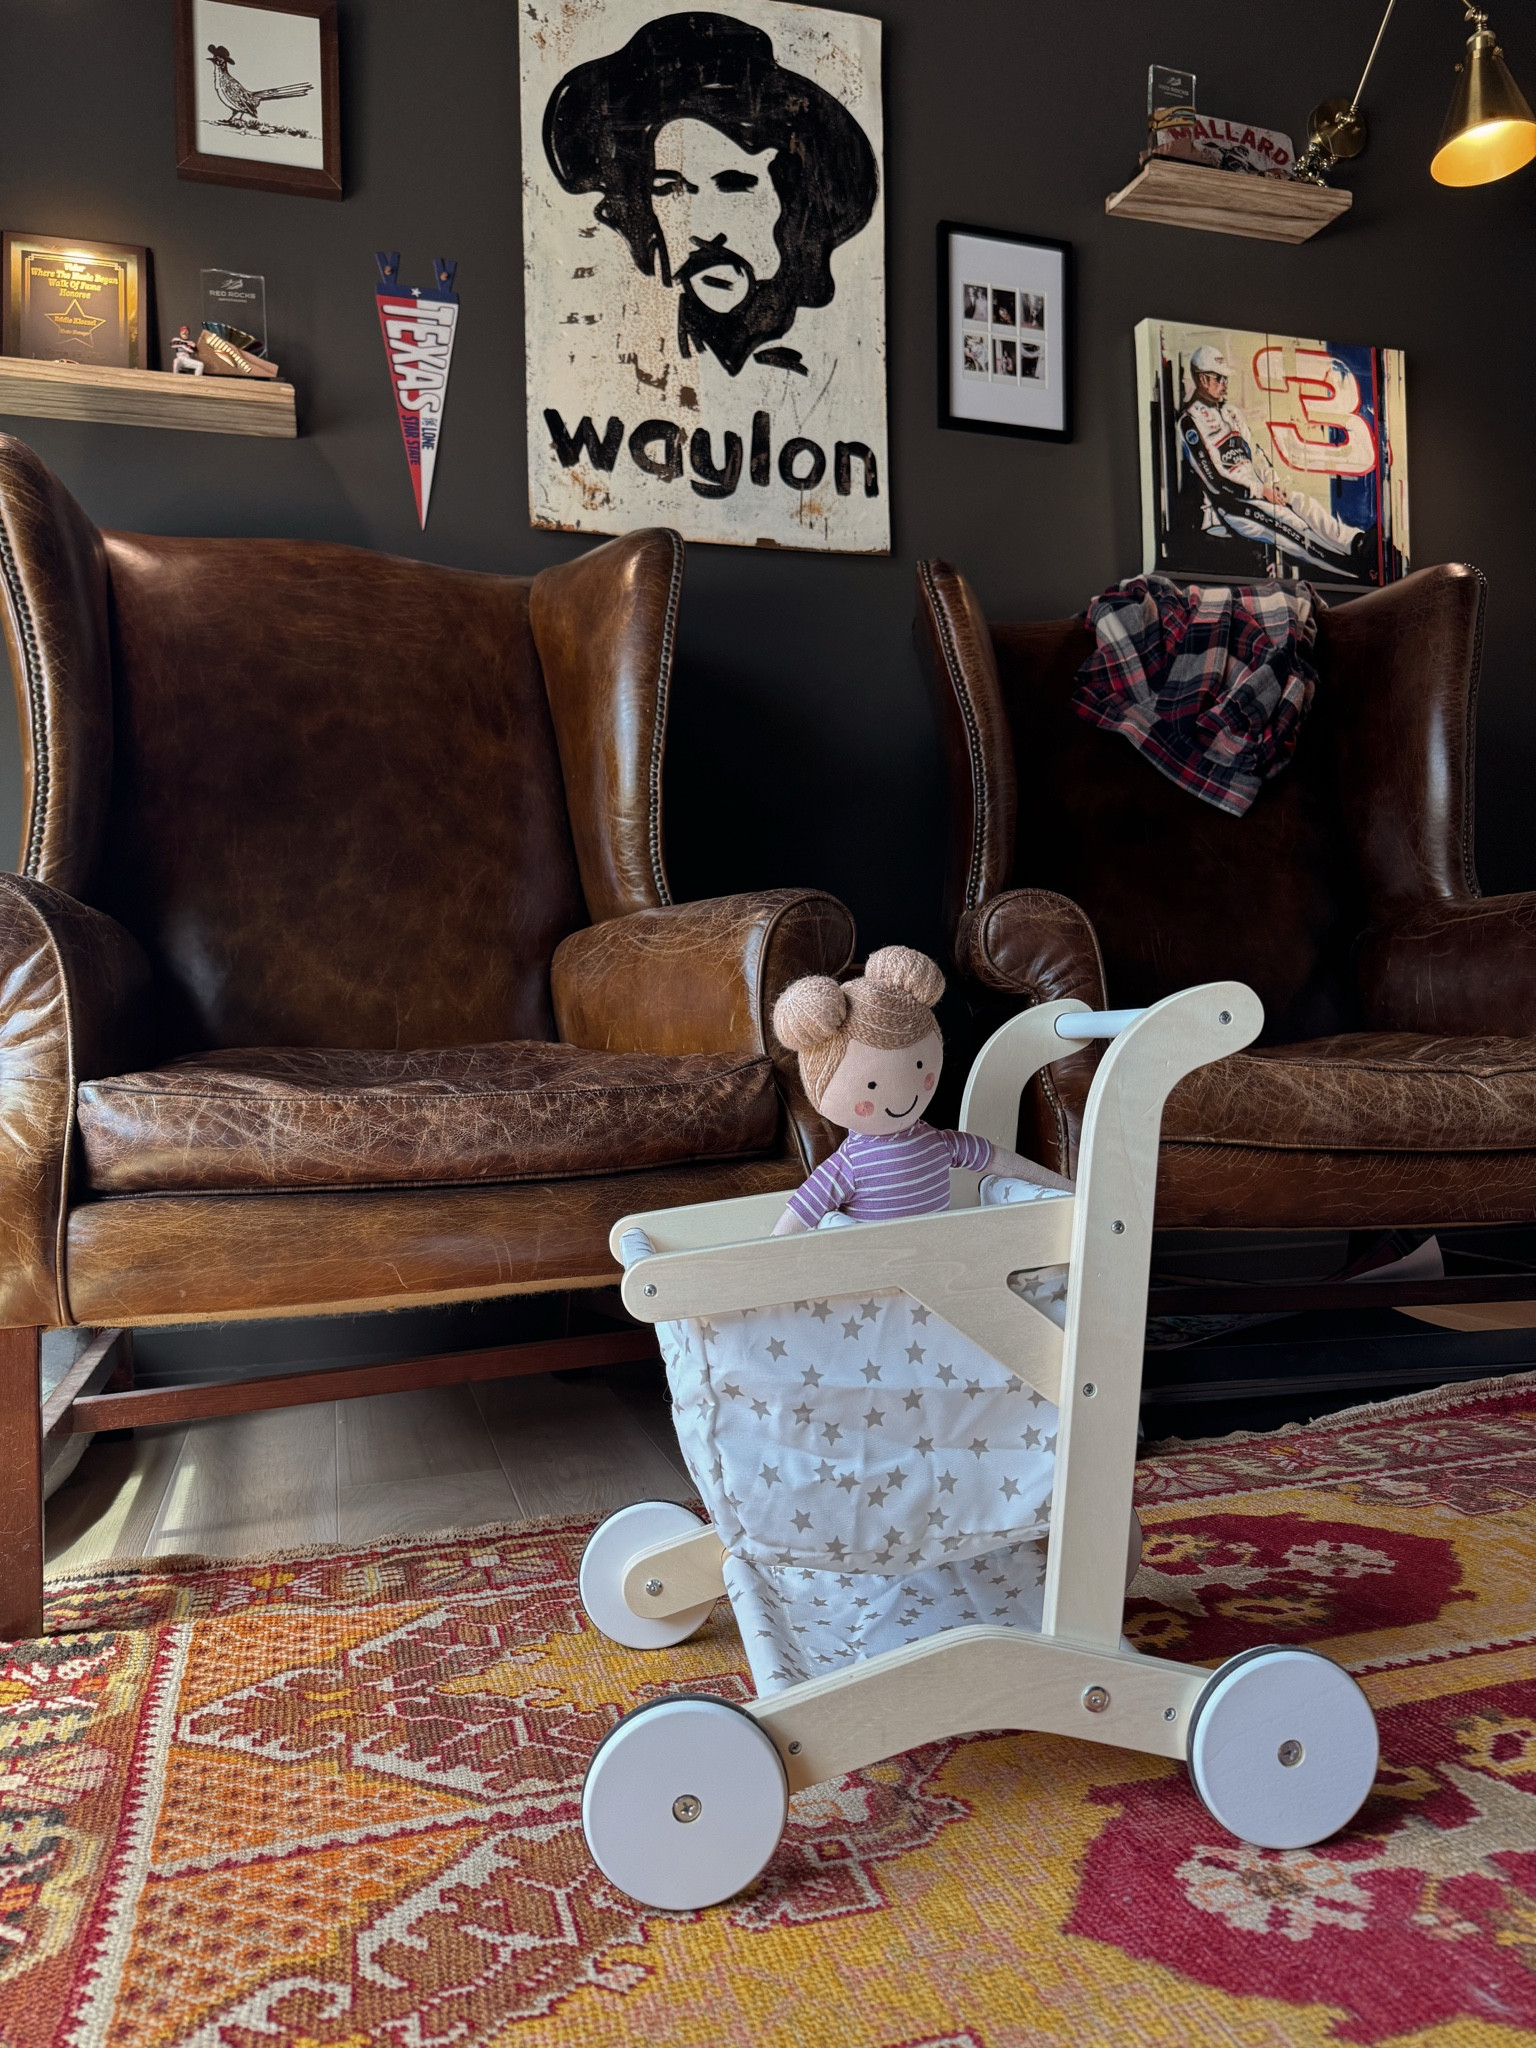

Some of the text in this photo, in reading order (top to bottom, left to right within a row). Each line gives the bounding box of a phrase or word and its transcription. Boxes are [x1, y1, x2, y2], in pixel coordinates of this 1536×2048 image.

[31, 267, 56, 278] Where
[56, 270, 71, 280] The
[95, 274, 119, 285] Began
[48, 278, 102, 292] Walk Of Fame
[59, 288, 92, 299] Honoree
[209, 289, 256, 300] RED ROCKS
[381, 304, 456, 413] TEXAS
[1252, 346, 1378, 477] 3
[401, 415, 421, 466] STAR STATE
[421, 427, 438, 451] LONE
[543, 408, 880, 500] waylon
